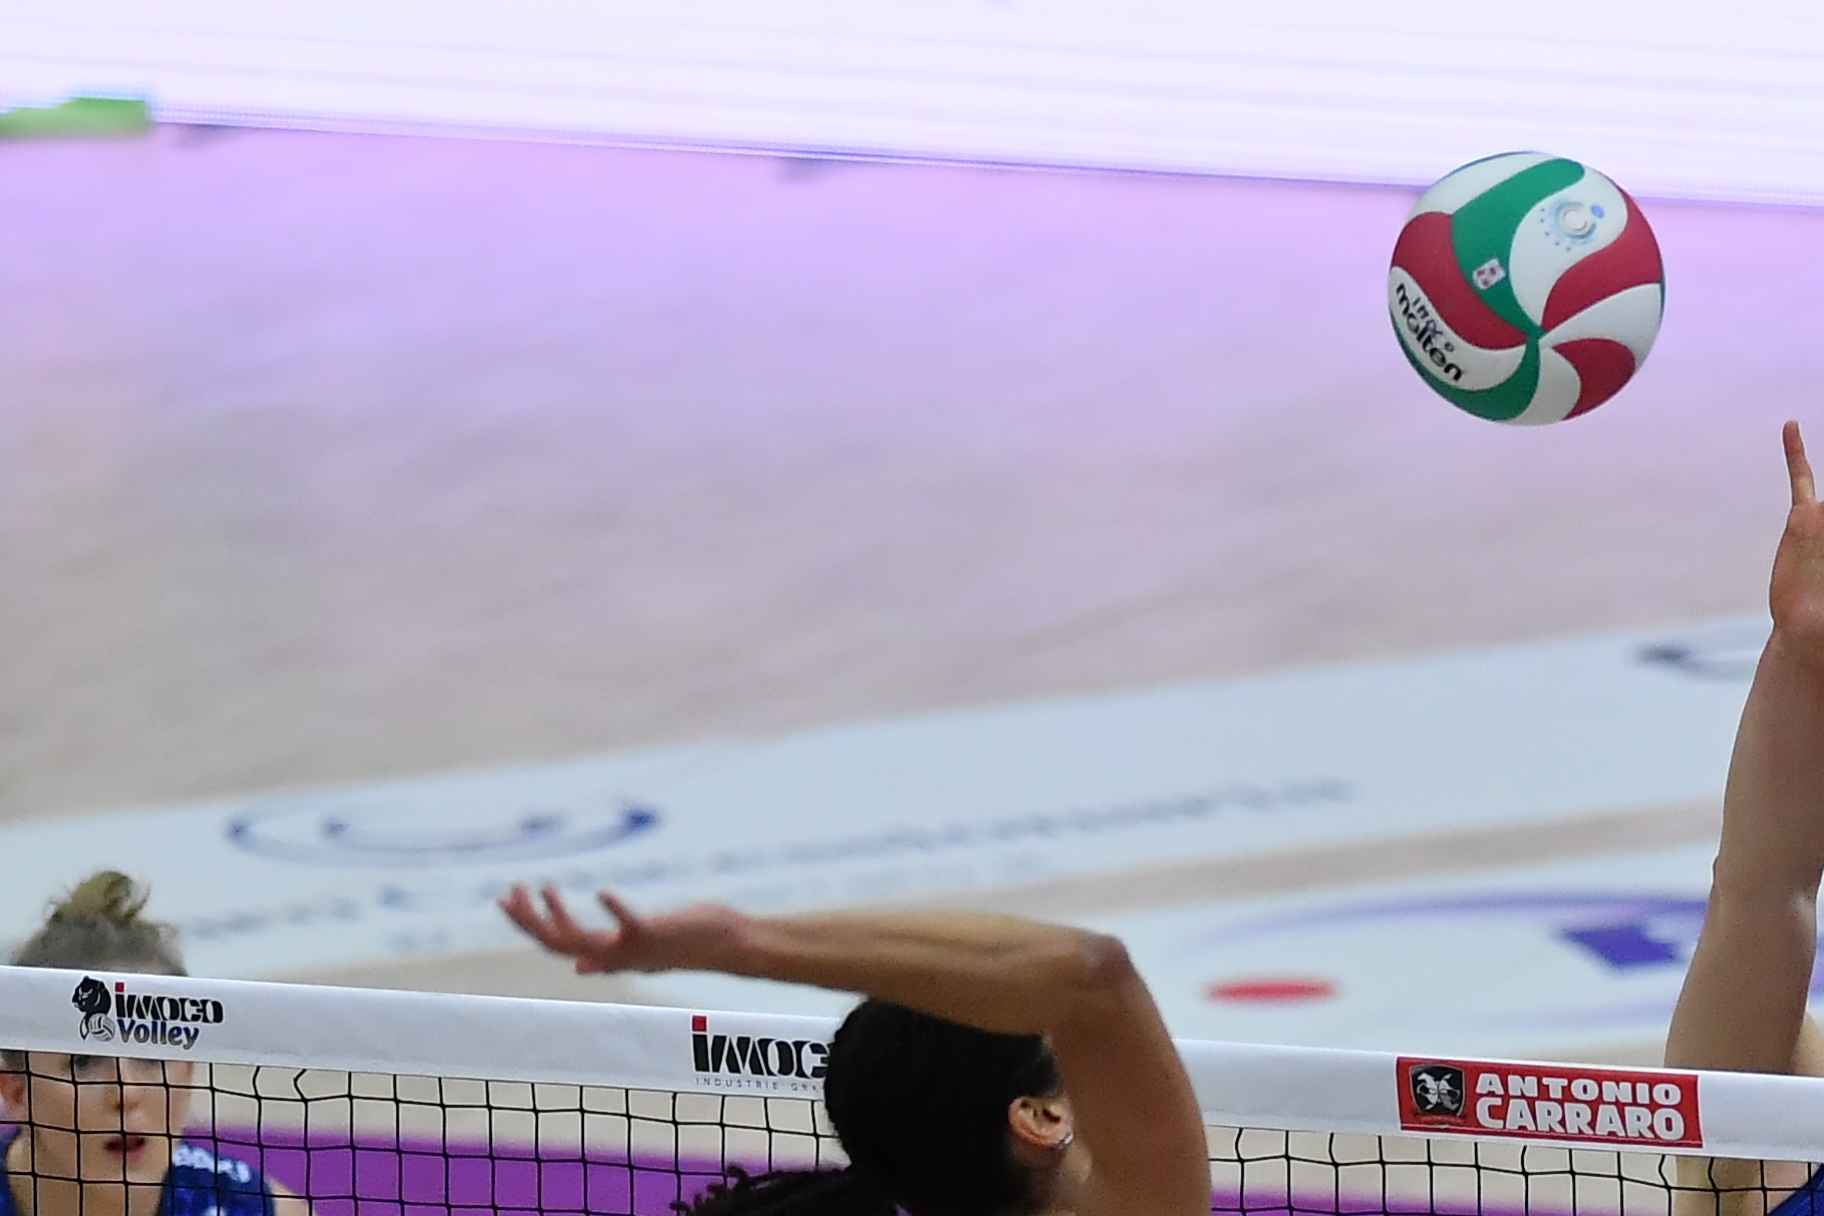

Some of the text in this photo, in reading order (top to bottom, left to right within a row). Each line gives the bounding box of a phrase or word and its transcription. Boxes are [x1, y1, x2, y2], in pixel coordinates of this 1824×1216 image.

[1395, 283, 1462, 381] molten
[117, 1019, 200, 1050] Volley
[1476, 1073, 1682, 1106] ANTONIO
[1476, 1097, 1685, 1140] CARRARO
